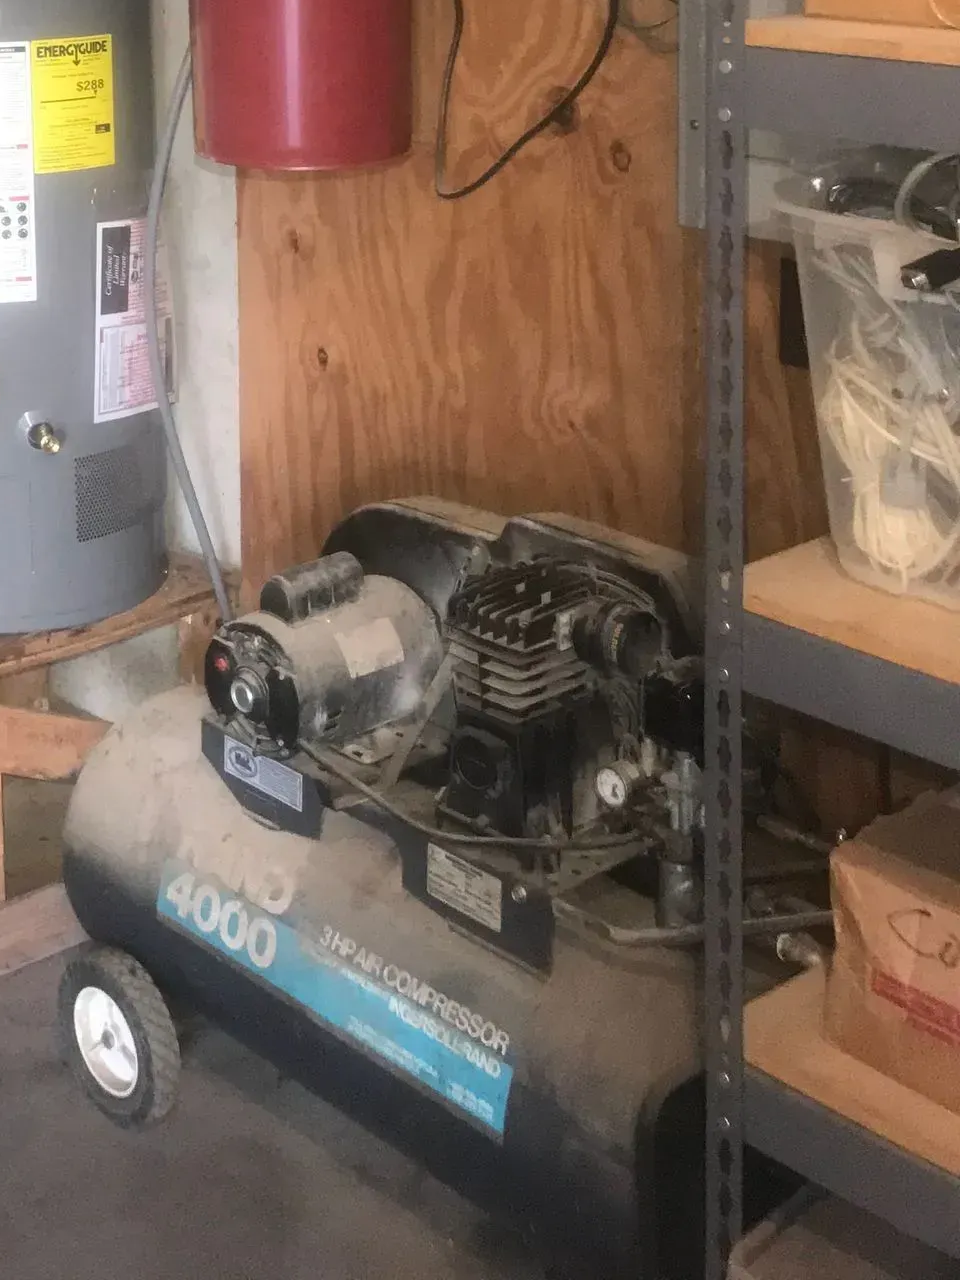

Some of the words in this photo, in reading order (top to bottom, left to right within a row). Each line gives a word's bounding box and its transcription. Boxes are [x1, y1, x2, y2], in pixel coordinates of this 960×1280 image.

[105, 244, 114, 255] of
[105, 256, 114, 296] Certificate
[112, 255, 121, 285] Limited
[166, 872, 277, 969] 4000
[319, 925, 333, 947] 3
[331, 936, 357, 958] HP
[353, 947, 384, 977] AIR
[383, 964, 510, 1056] COMPRESSOR
